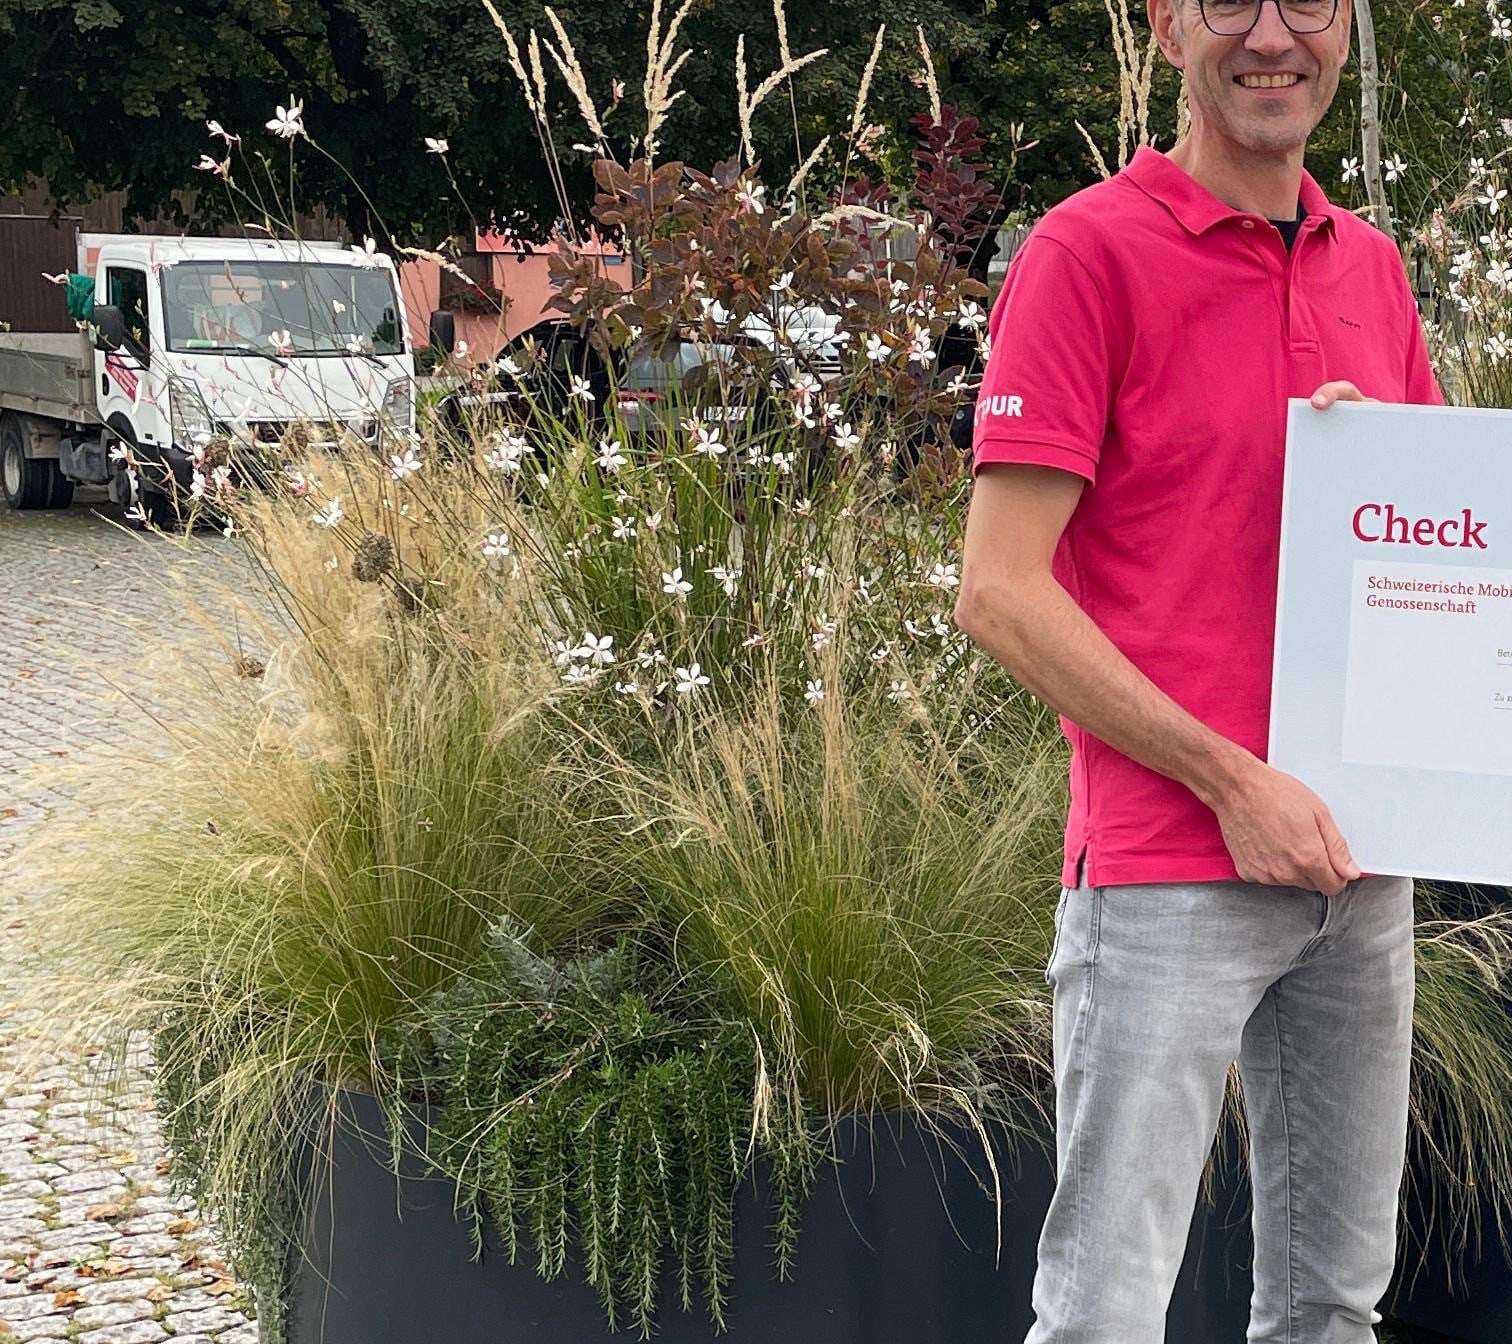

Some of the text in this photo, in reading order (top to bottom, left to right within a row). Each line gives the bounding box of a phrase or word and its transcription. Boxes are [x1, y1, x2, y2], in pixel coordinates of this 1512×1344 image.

[1352, 503, 1488, 549] Check
[1367, 576, 1474, 595] Schweizerische
[1366, 595, 1477, 614] Genossenschaft
[1494, 692, 1505, 702] Zu
